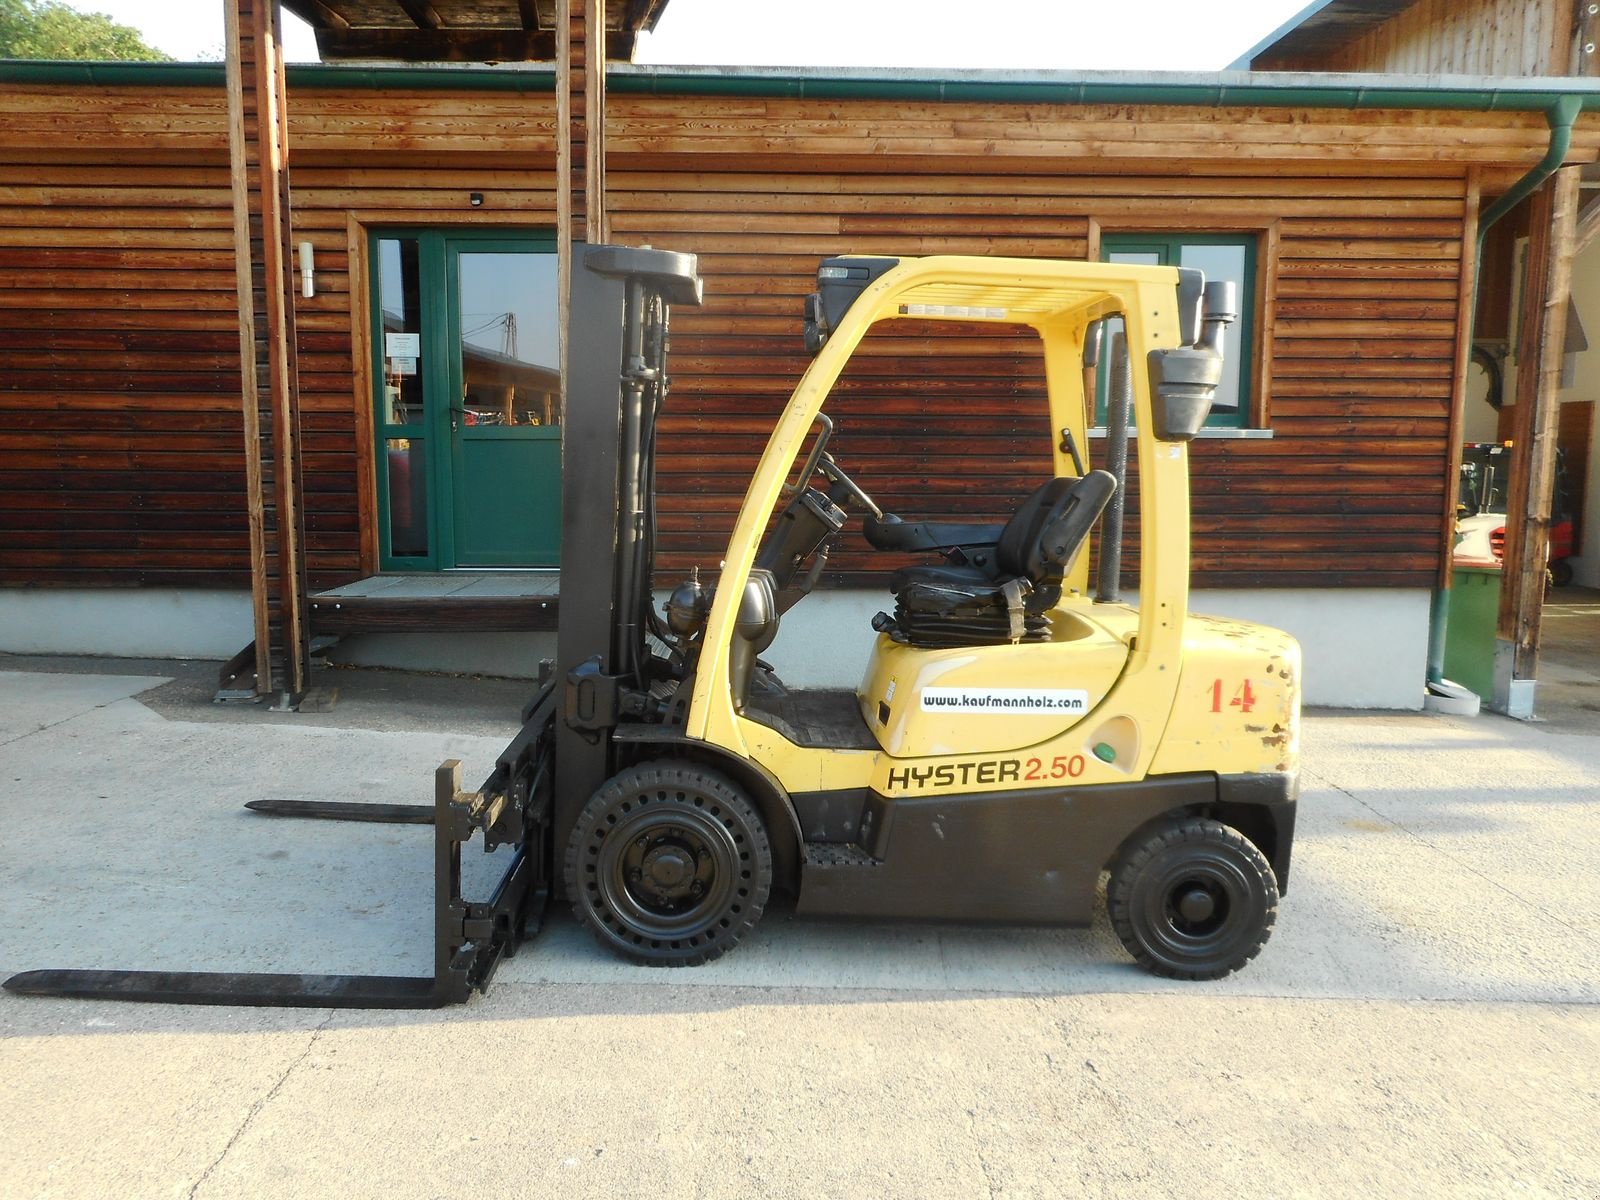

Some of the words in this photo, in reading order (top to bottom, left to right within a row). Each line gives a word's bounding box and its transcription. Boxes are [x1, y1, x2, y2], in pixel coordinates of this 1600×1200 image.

[923, 694, 1083, 708] www.kaufmannholz.com
[1206, 679, 1256, 712] 14
[887, 759, 1021, 790] HYSTER
[1024, 754, 1086, 781] 2.50
